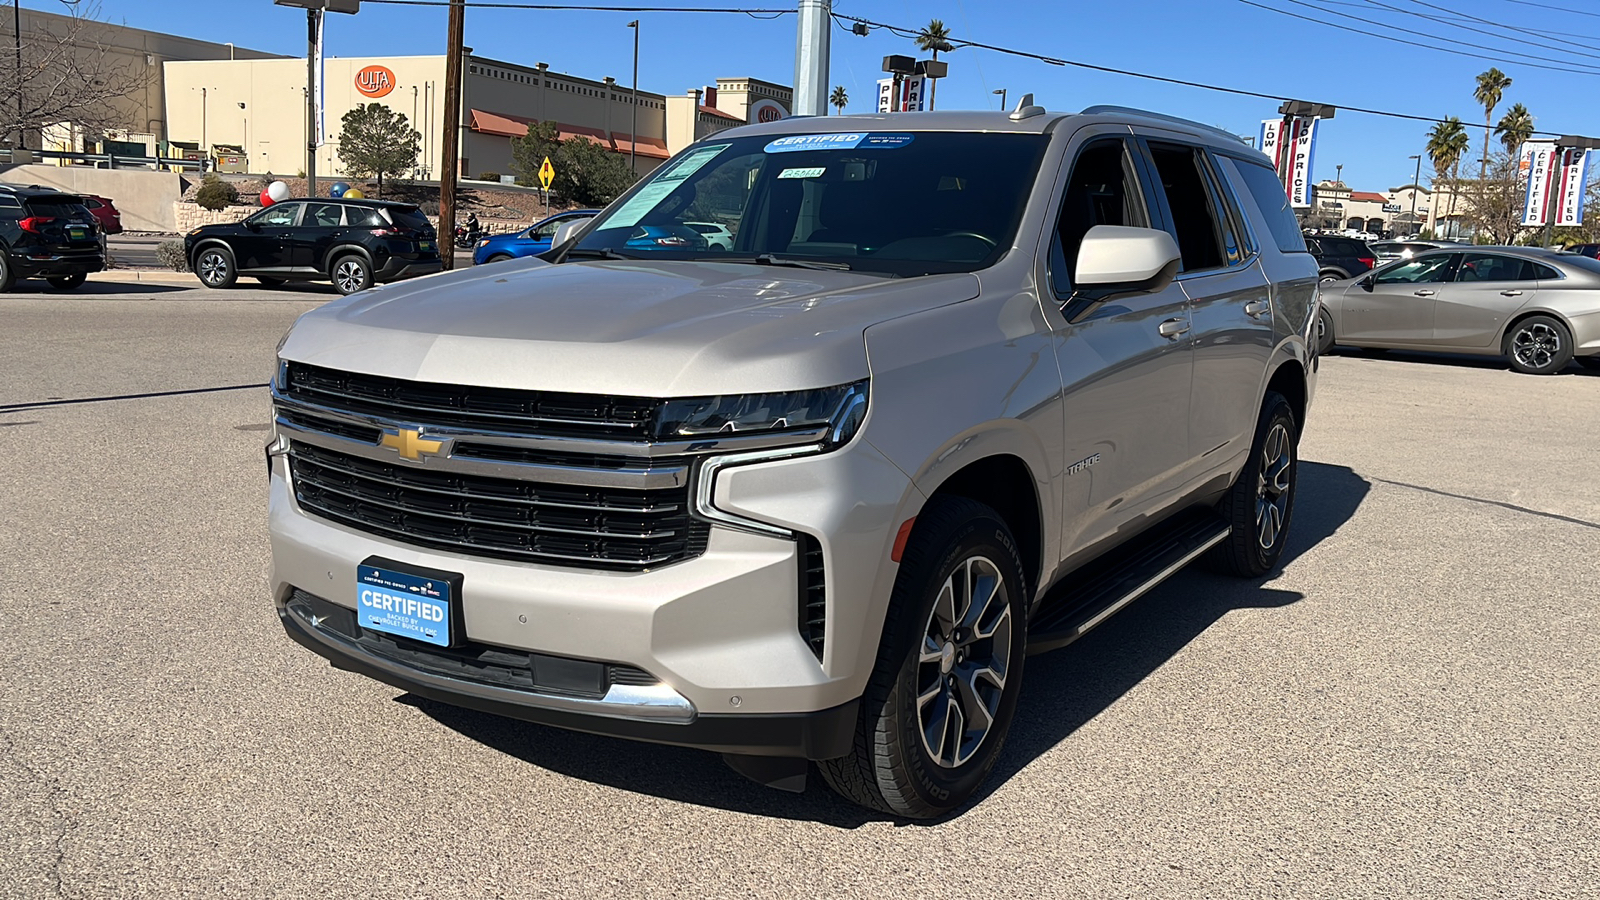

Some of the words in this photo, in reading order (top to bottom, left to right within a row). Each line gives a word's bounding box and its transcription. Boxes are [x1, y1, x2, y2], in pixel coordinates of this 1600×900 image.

[359, 71, 389, 87] ULTA
[760, 109, 780, 122] ULTA
[773, 135, 859, 145] CERTIFIED
[1264, 123, 1276, 147] LOW
[1299, 120, 1310, 145] LOW
[1293, 153, 1305, 203] PRICES
[1529, 152, 1547, 222] CERTIFIED
[1565, 151, 1583, 222] CERTIFIED
[1067, 453, 1100, 476] TAHOE
[364, 576, 384, 584] CERTIFIED
[361, 591, 443, 622] CERTIFIED
[387, 613, 409, 623] BACKED
[368, 615, 400, 627] CHEVROLET
[402, 622, 419, 632] BUICK
[425, 627, 438, 636] GMC
[905, 654, 950, 801] CONTINENTAL
